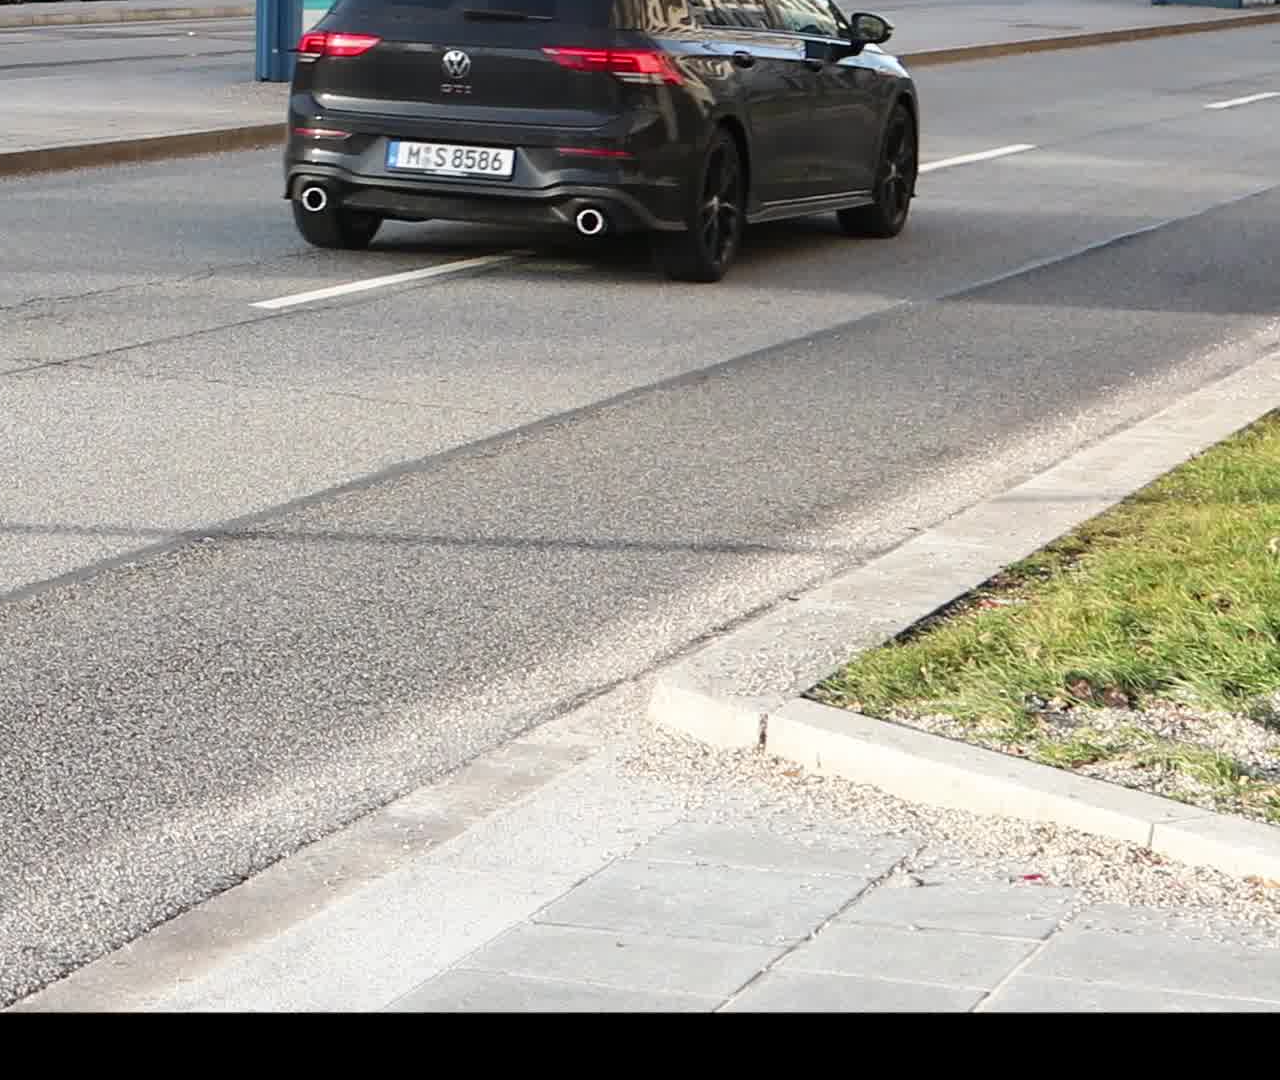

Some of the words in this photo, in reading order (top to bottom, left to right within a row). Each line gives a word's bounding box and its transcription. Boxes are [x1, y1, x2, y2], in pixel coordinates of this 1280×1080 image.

[407, 144, 421, 165] M
[434, 147, 447, 167] S
[451, 148, 503, 171] 8586
